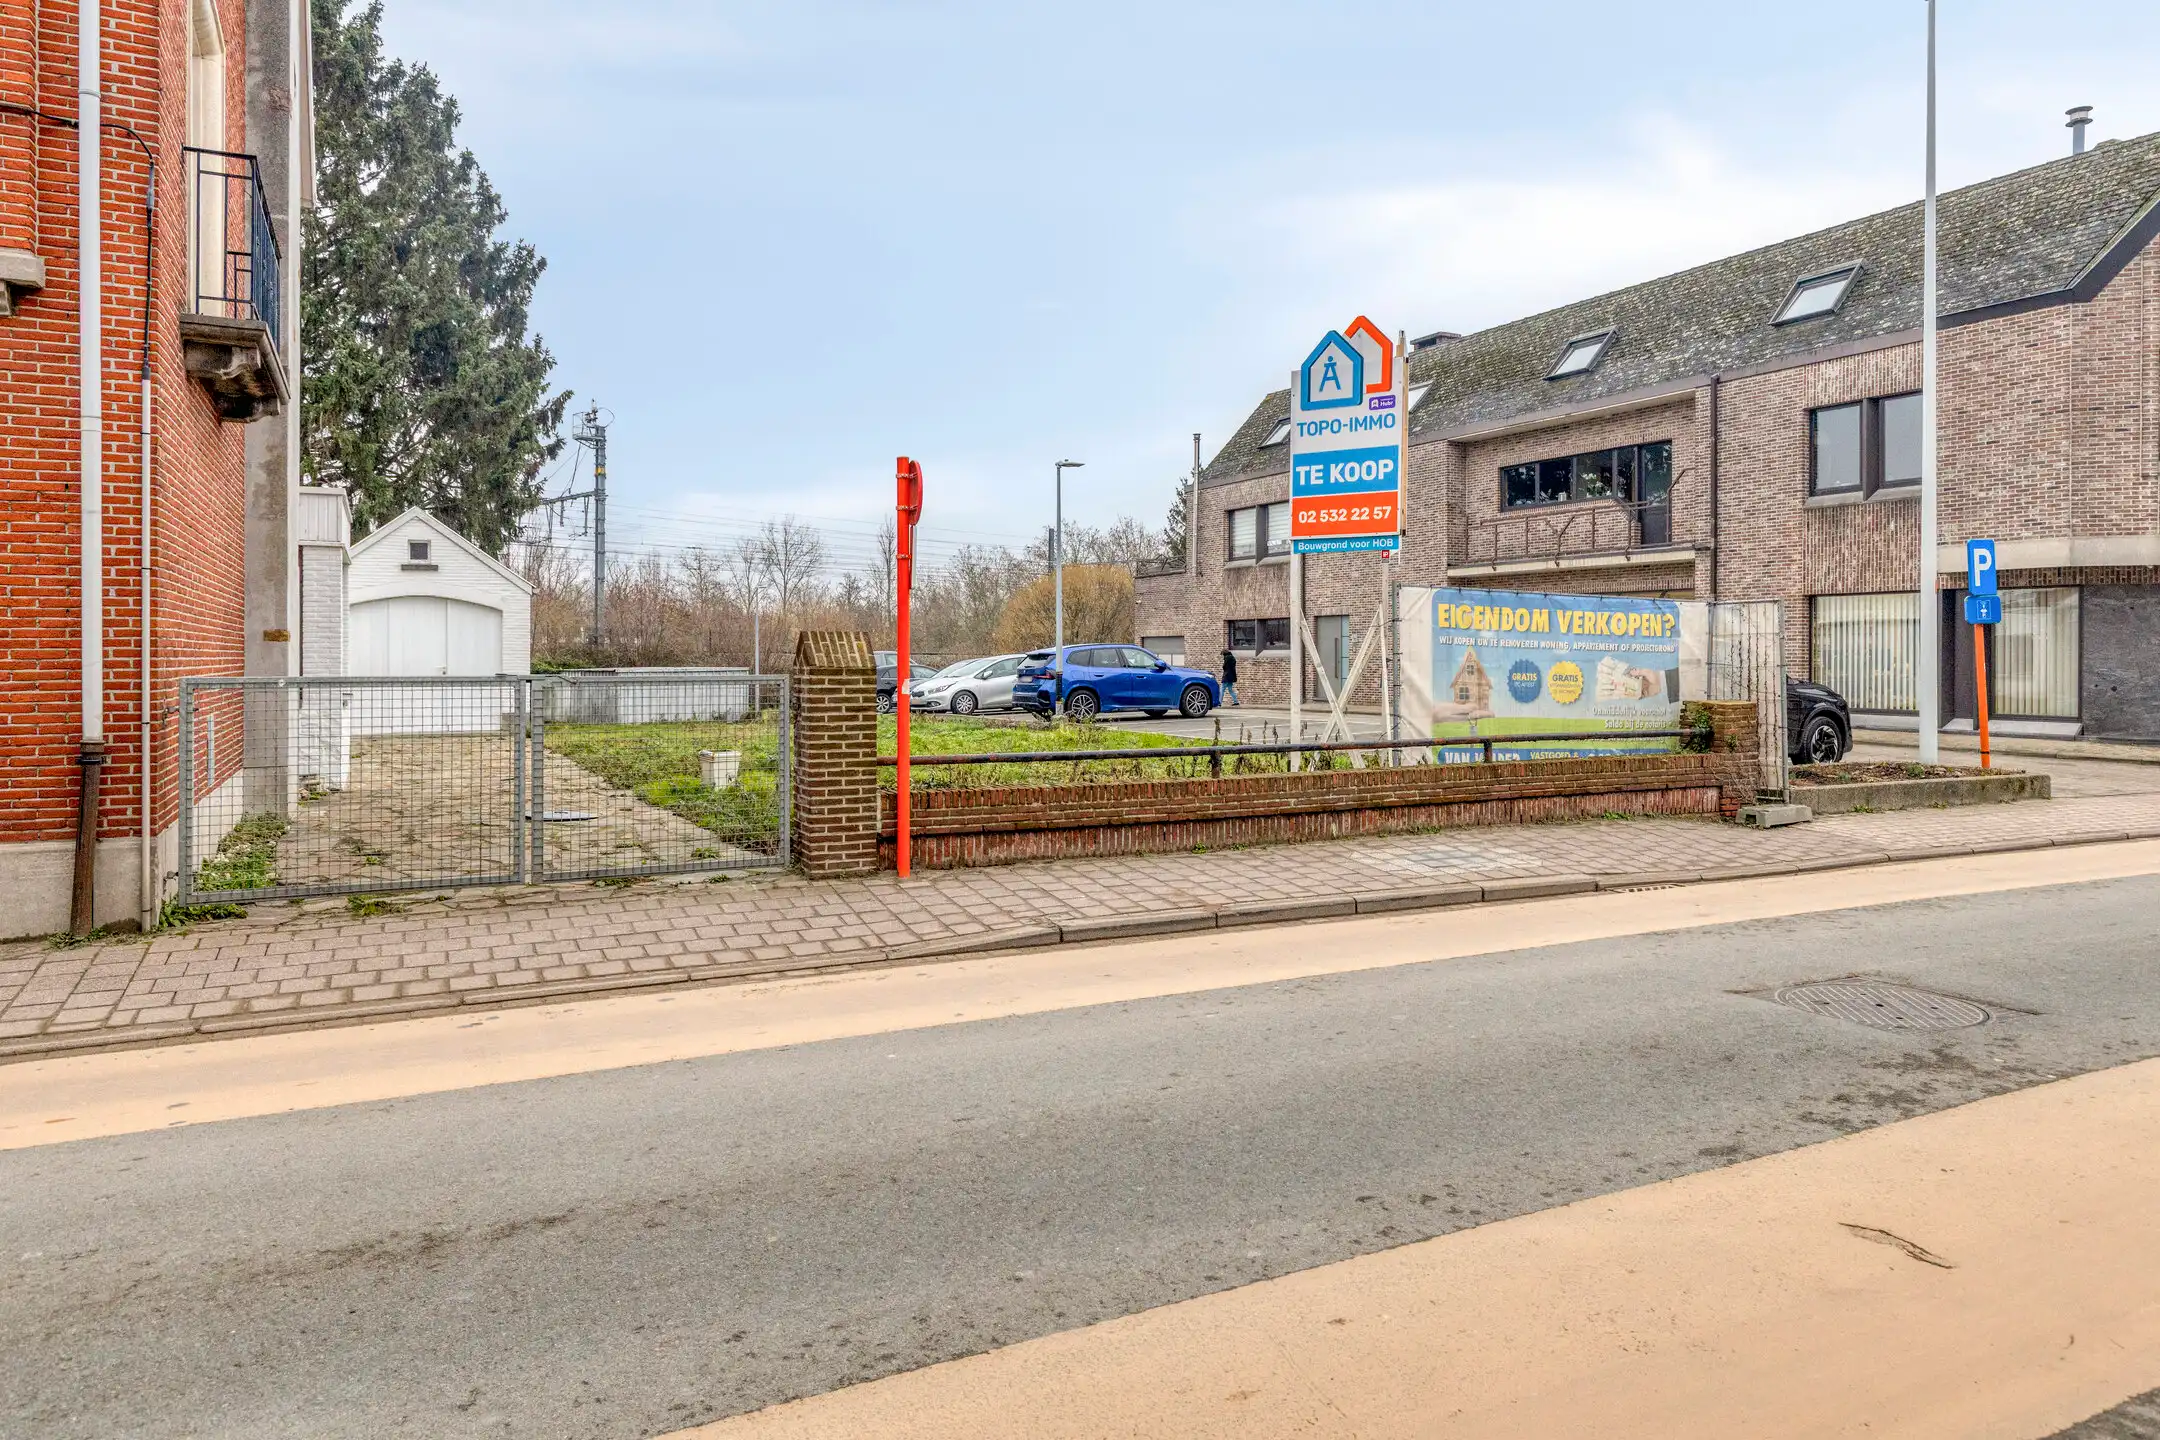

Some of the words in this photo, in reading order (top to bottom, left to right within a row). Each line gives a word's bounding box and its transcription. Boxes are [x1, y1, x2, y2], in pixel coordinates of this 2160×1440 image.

[1297, 413, 1396, 437] TOPO-IMMO
[1296, 465, 1324, 485] TE
[1330, 459, 1394, 483] KOOP
[1299, 510, 1317, 523] 02
[1320, 508, 1347, 523] 532
[1351, 507, 1369, 521] 22
[1373, 506, 1392, 519] 57
[1298, 540, 1347, 551] Bouwgrond
[1373, 538, 1393, 547] HOB
[1974, 548, 1992, 587] P
[1438, 603, 1550, 633] EIGENDOM
[1557, 610, 1676, 637] VERKOPEN?
[1440, 636, 1452, 645] WIJ
[1454, 637, 1475, 646] KOPEN
[1478, 637, 1488, 646] UW
[1490, 638, 1498, 647] TE
[1501, 639, 1539, 649] RENOVEREN
[1574, 641, 1619, 651] APPARTEMENT
[1621, 643, 1630, 651] OF
[1512, 672, 1537, 681] GRATIS
[1552, 674, 1579, 682] GRATIS
